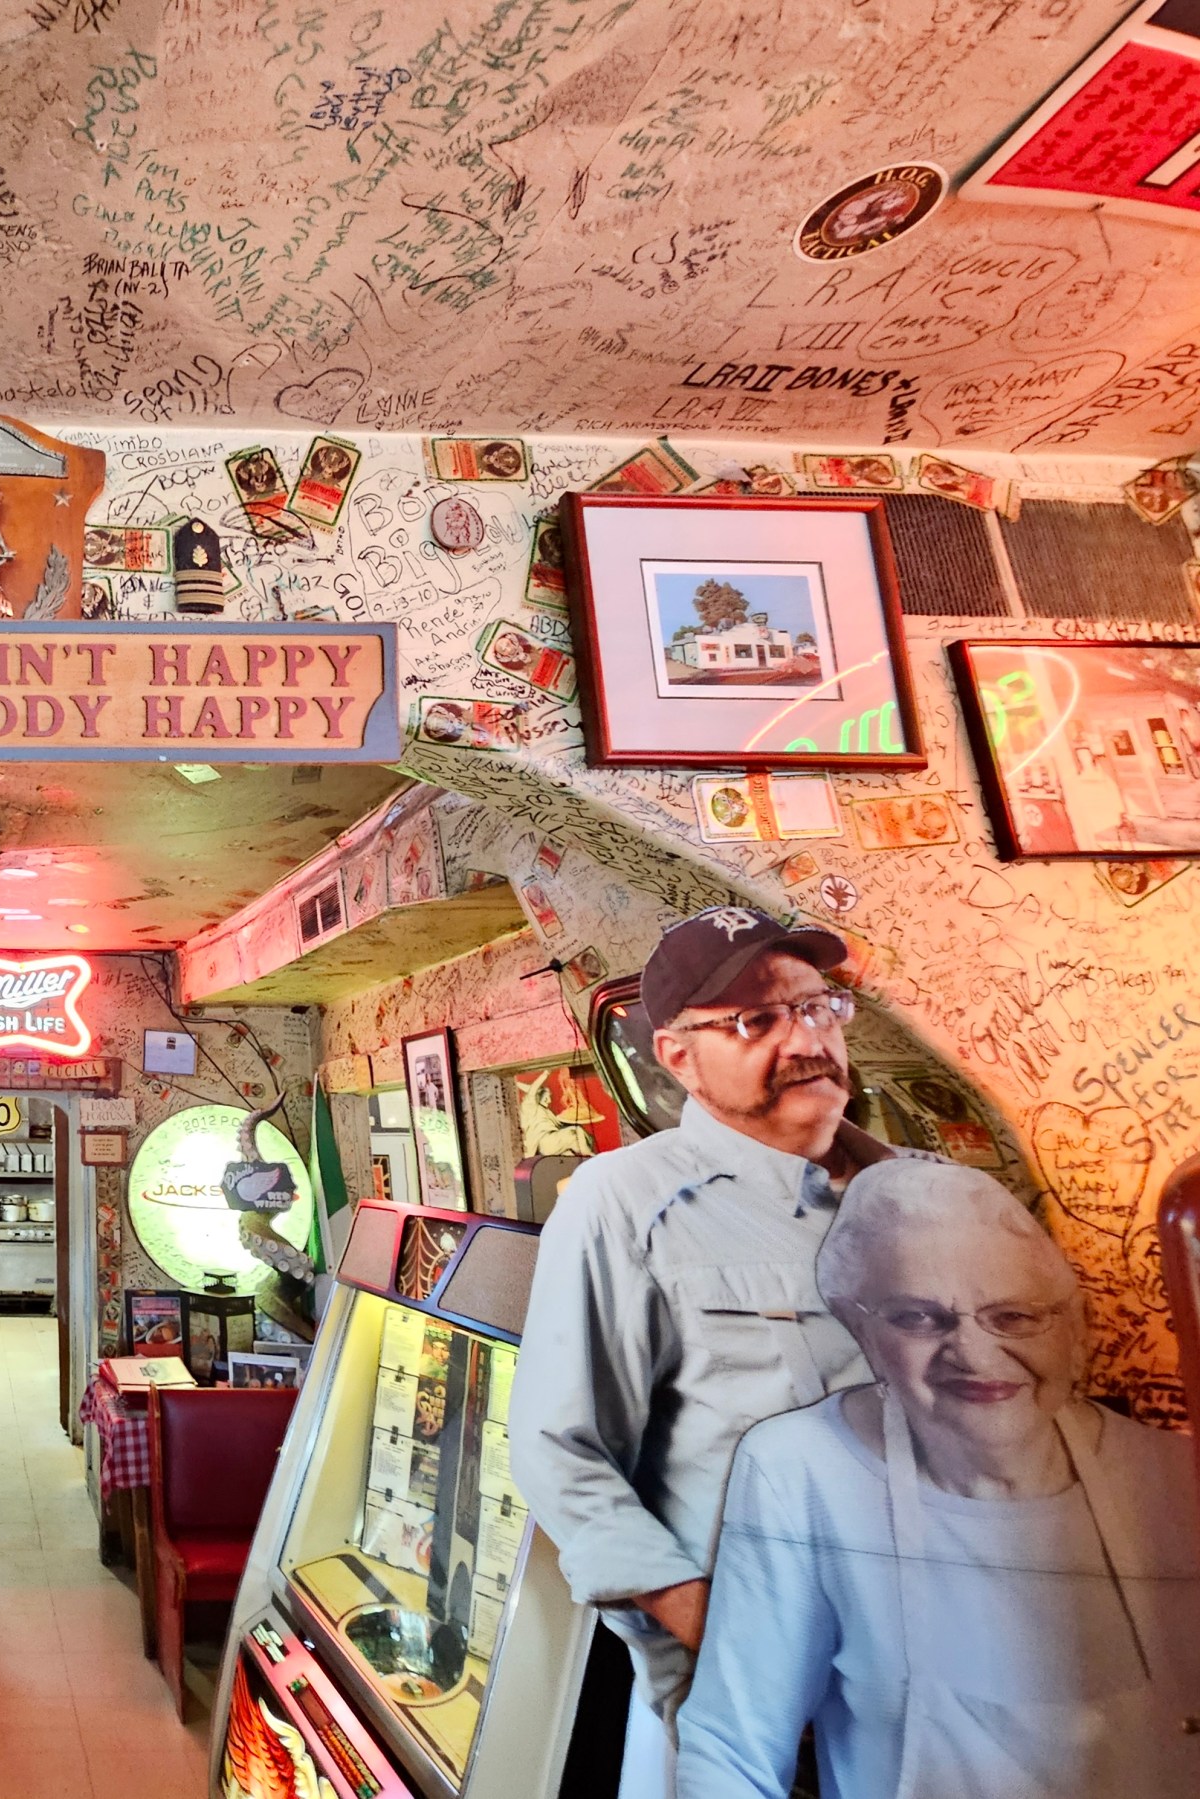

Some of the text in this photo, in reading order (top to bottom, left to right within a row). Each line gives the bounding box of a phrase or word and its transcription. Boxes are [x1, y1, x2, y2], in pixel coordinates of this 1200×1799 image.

[83, 253, 126, 276] BRIAN
[786, 364, 902, 396] BONES
[148, 643, 362, 688] HAPPY
[142, 695, 356, 739] HAPPY
[25, 1012, 66, 1033] LIFE
[48, 1062, 99, 1077] CUCINA
[182, 1115, 217, 1132] 2012
